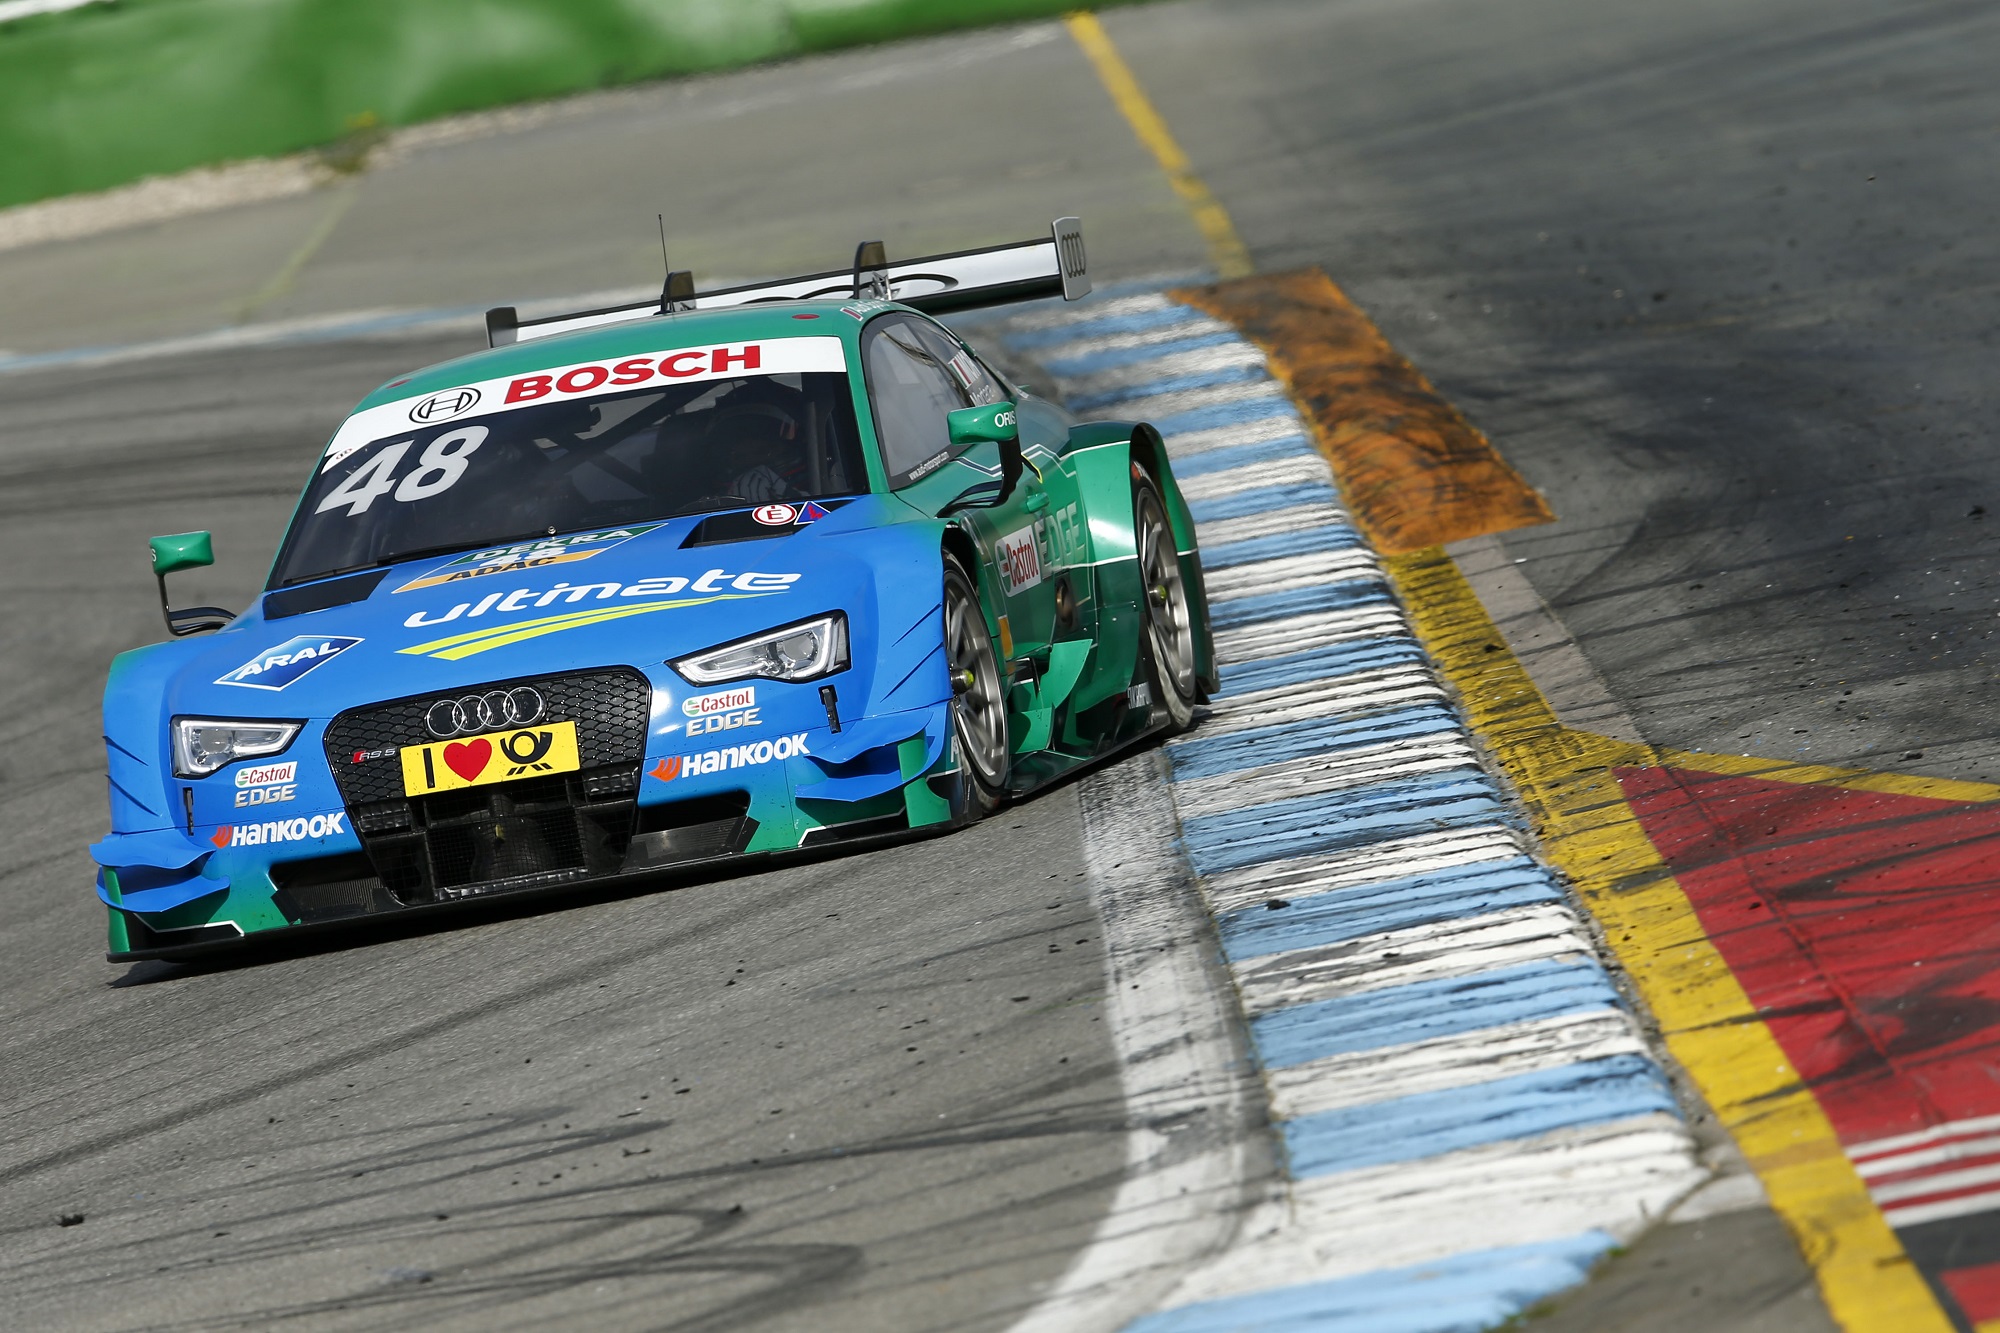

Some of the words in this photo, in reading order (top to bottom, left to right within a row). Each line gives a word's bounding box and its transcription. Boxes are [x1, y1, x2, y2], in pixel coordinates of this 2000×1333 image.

[503, 345, 761, 405] BOSCH
[994, 411, 1017, 428] ORIS
[314, 425, 490, 517] 48
[471, 529, 633, 561] DEKRA
[1005, 534, 1039, 588] Castrol
[1034, 501, 1085, 580] EDGE
[446, 556, 557, 582] ADAC
[403, 568, 802, 628] ultimate
[234, 642, 341, 681] ARAL
[701, 690, 751, 713] Castrol
[686, 706, 763, 737] EDGE
[249, 764, 292, 784] Castrol
[234, 783, 298, 809] EDGE
